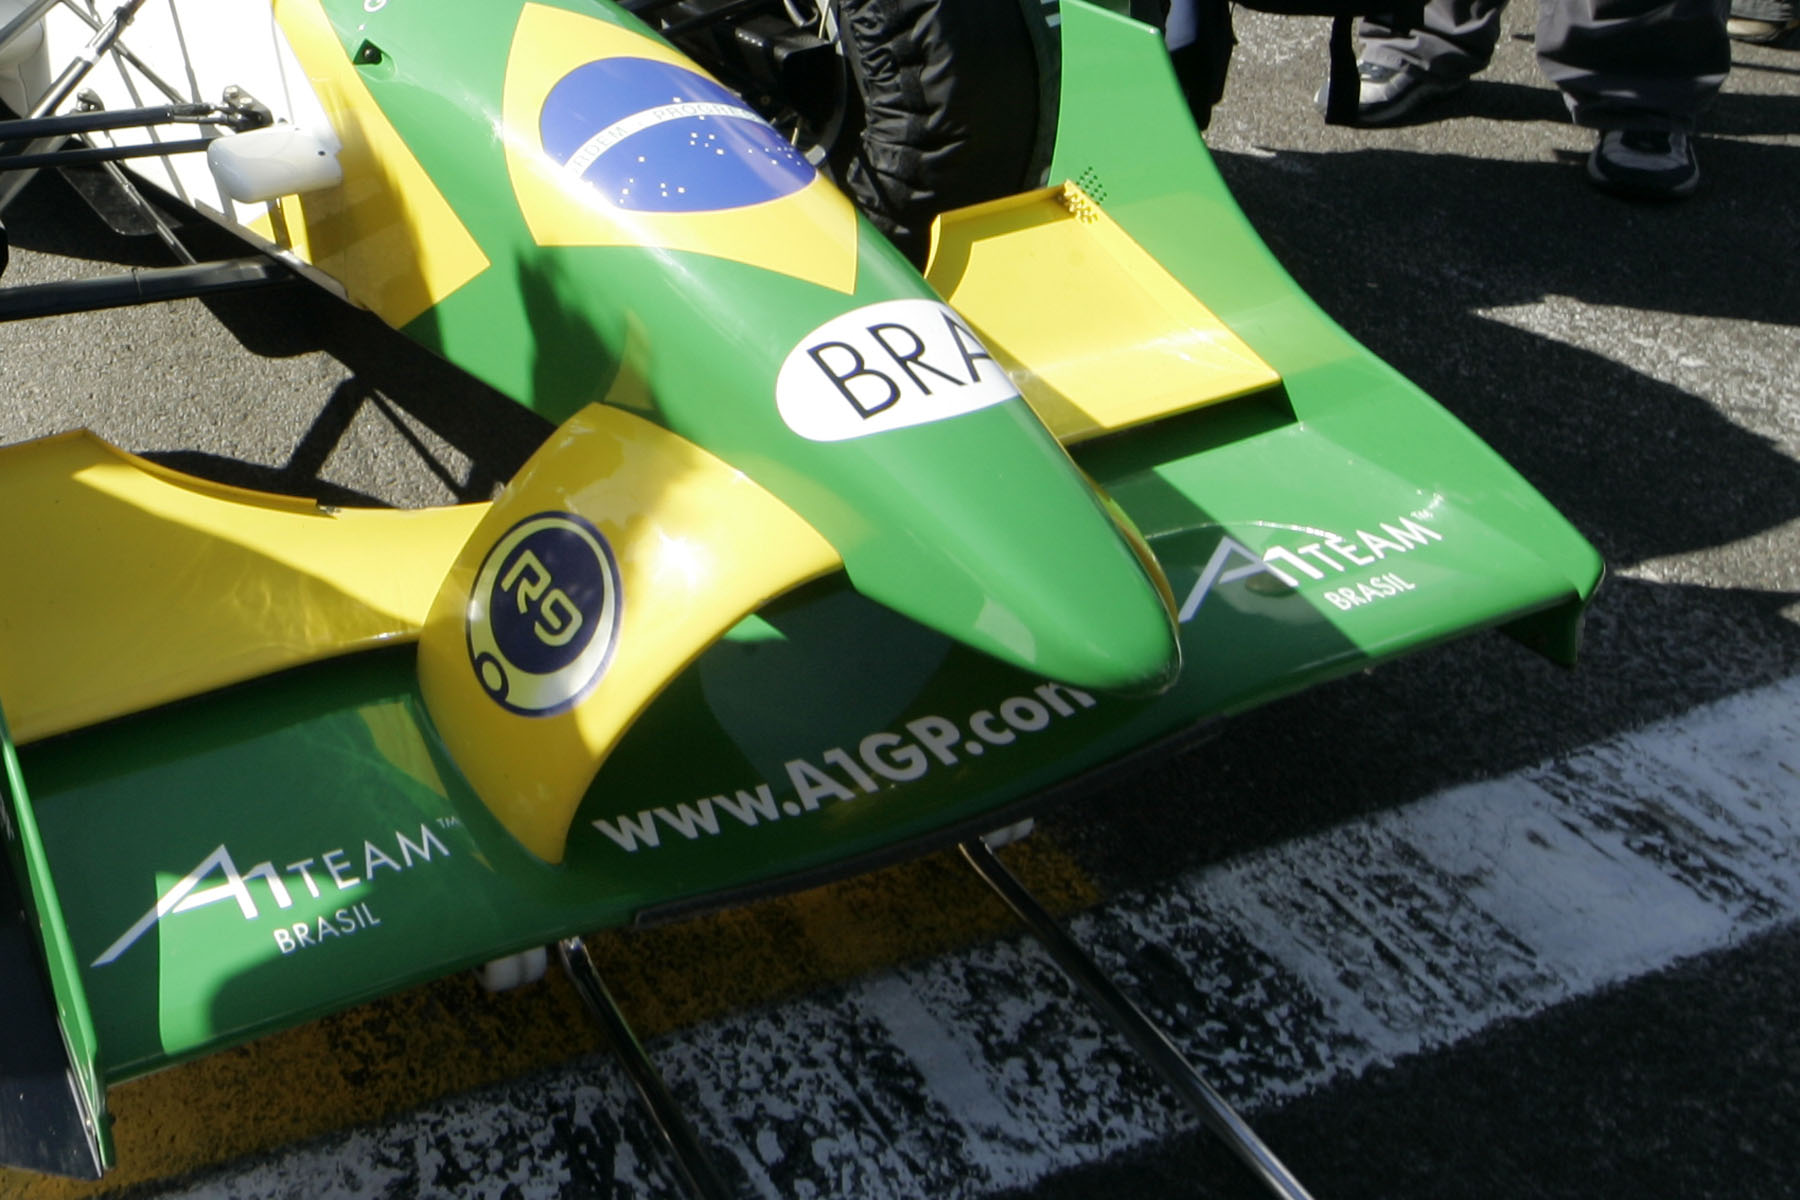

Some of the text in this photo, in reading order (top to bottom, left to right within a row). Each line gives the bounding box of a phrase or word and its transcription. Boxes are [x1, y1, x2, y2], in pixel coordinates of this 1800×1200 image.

[806, 310, 995, 420] BRA
[1323, 571, 1416, 611] BRASIL
[273, 901, 382, 954] BRASIL
